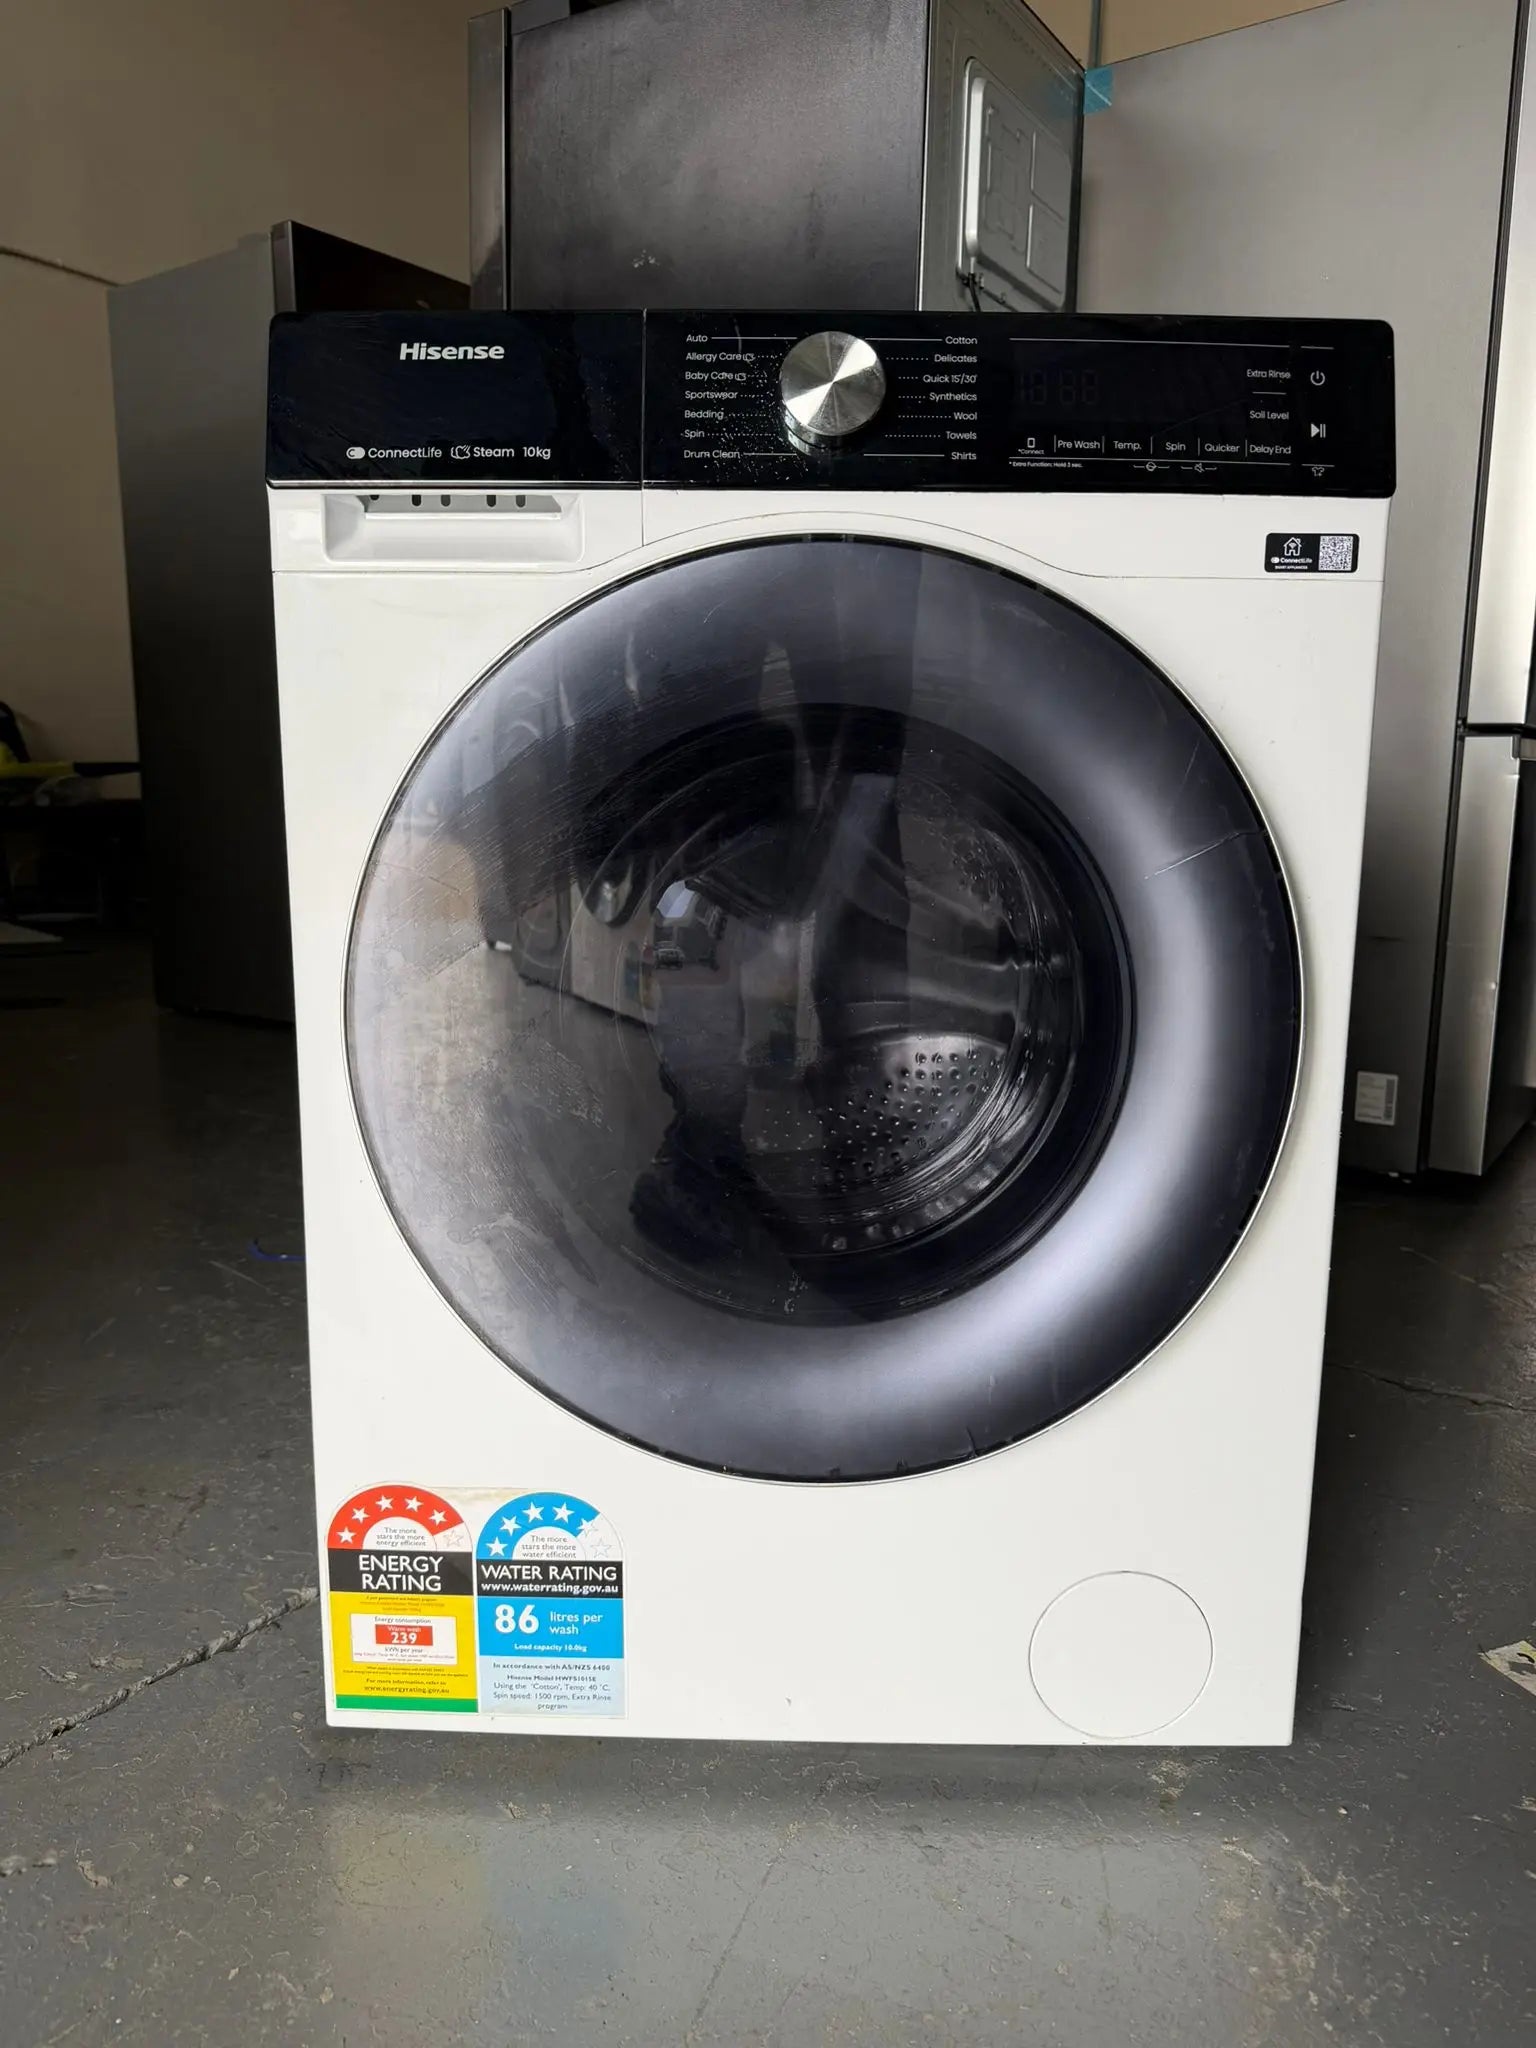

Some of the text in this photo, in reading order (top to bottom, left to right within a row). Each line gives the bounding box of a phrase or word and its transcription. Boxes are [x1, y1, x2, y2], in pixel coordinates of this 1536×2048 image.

[686, 333, 708, 343] Auto
[945, 335, 978, 345] Cotton
[400, 342, 505, 361] Hisense
[686, 352, 742, 362] Allergy Care
[934, 353, 978, 363] Delicates
[685, 371, 734, 382] Baby Care
[1247, 368, 1291, 379] Extra Rinse
[923, 374, 950, 384] Quick
[685, 390, 739, 401] Sportswear
[929, 392, 978, 403] Synthetics
[684, 409, 725, 421] Bedding
[953, 411, 978, 421] Wool
[1249, 410, 1290, 421] Soil Level
[684, 428, 705, 440] Spin
[945, 430, 978, 440] Towels
[1057, 440, 1101, 450] Pre Wash
[1113, 440, 1142, 452] Temp.
[1165, 442, 1187, 452] Spin
[1204, 443, 1240, 453] Quicker
[1250, 444, 1292, 456] Delay End
[368, 446, 551, 461] ConnectLife Steam 10kg
[683, 449, 741, 459] Drum Clean
[951, 451, 977, 461] Shirts
[376, 1533, 393, 1541] stars
[531, 1534, 546, 1543] The
[376, 1540, 427, 1548] energy efficient
[522, 1543, 541, 1551] stars
[542, 1543, 556, 1551] the
[545, 1550, 577, 1559] efficient
[358, 1554, 444, 1574] ENERGY
[480, 1564, 618, 1582] WATER RATING
[361, 1573, 443, 1592] RATING
[480, 1582, 619, 1596] www.waterrating.gov.au
[374, 1615, 432, 1625] Energy consumption
[494, 1603, 540, 1635] 86
[549, 1611, 604, 1626] litres per
[549, 1624, 579, 1636] wash
[390, 1631, 418, 1645] 239
[400, 1648, 411, 1656] per
[514, 1643, 533, 1651] Load
[533, 1644, 562, 1653] capacity
[493, 1681, 514, 1691] Using
[493, 1691, 509, 1701] Spin
[534, 1692, 552, 1700] 1500
[571, 1693, 591, 1701] Extra
[592, 1693, 612, 1701] Rinse
[537, 1703, 568, 1712] program
